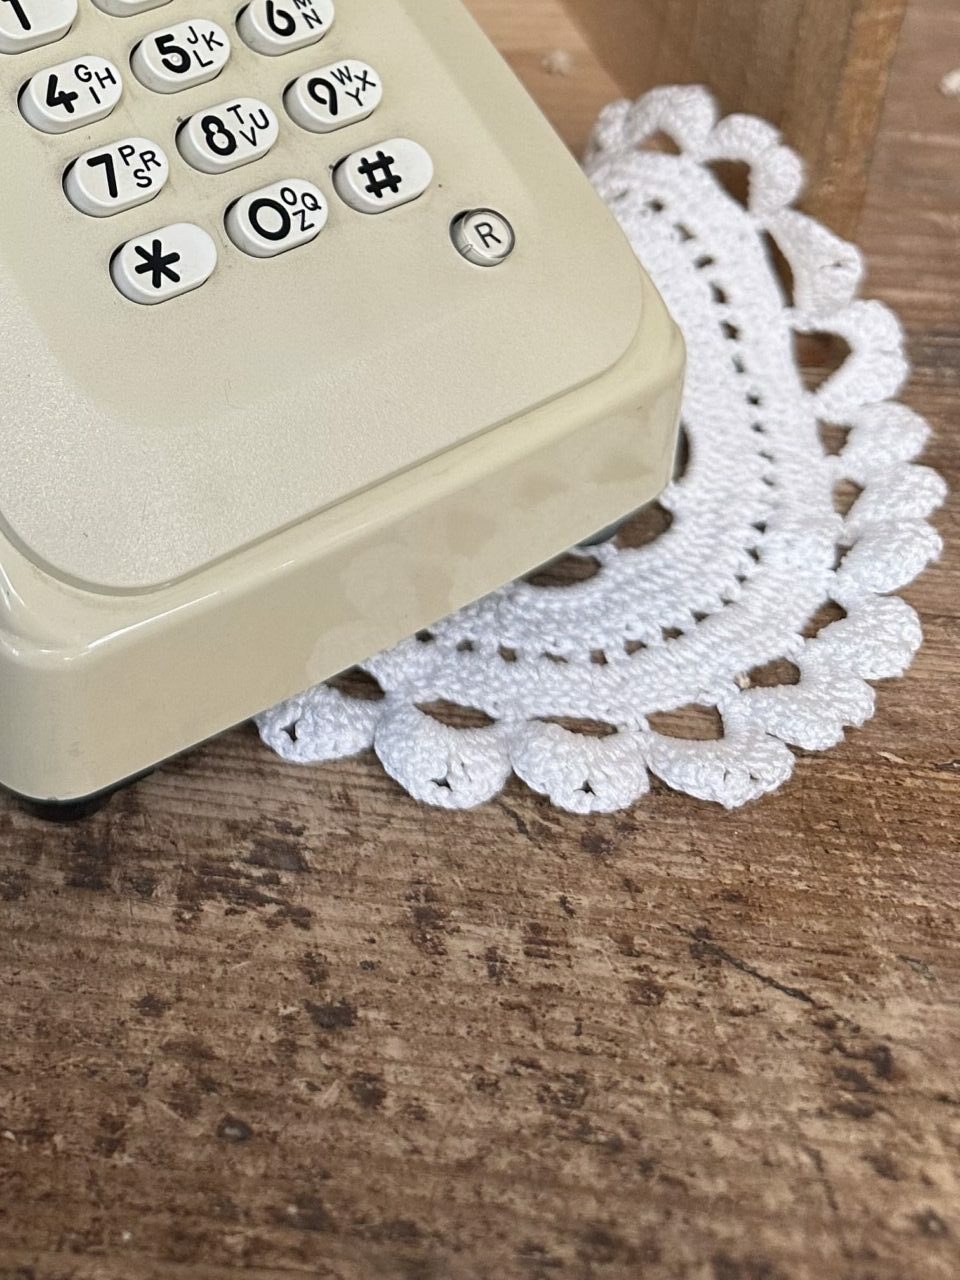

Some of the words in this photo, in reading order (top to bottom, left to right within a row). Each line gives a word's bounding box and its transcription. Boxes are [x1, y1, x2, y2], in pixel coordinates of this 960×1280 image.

[266, 0, 297, 37] 6
[154, 33, 192, 74] 5
[45, 74, 79, 114] 4
[307, 77, 338, 116] 9
[200, 115, 238, 157] 8
[86, 153, 119, 199] 7
[474, 221, 502, 249] R
